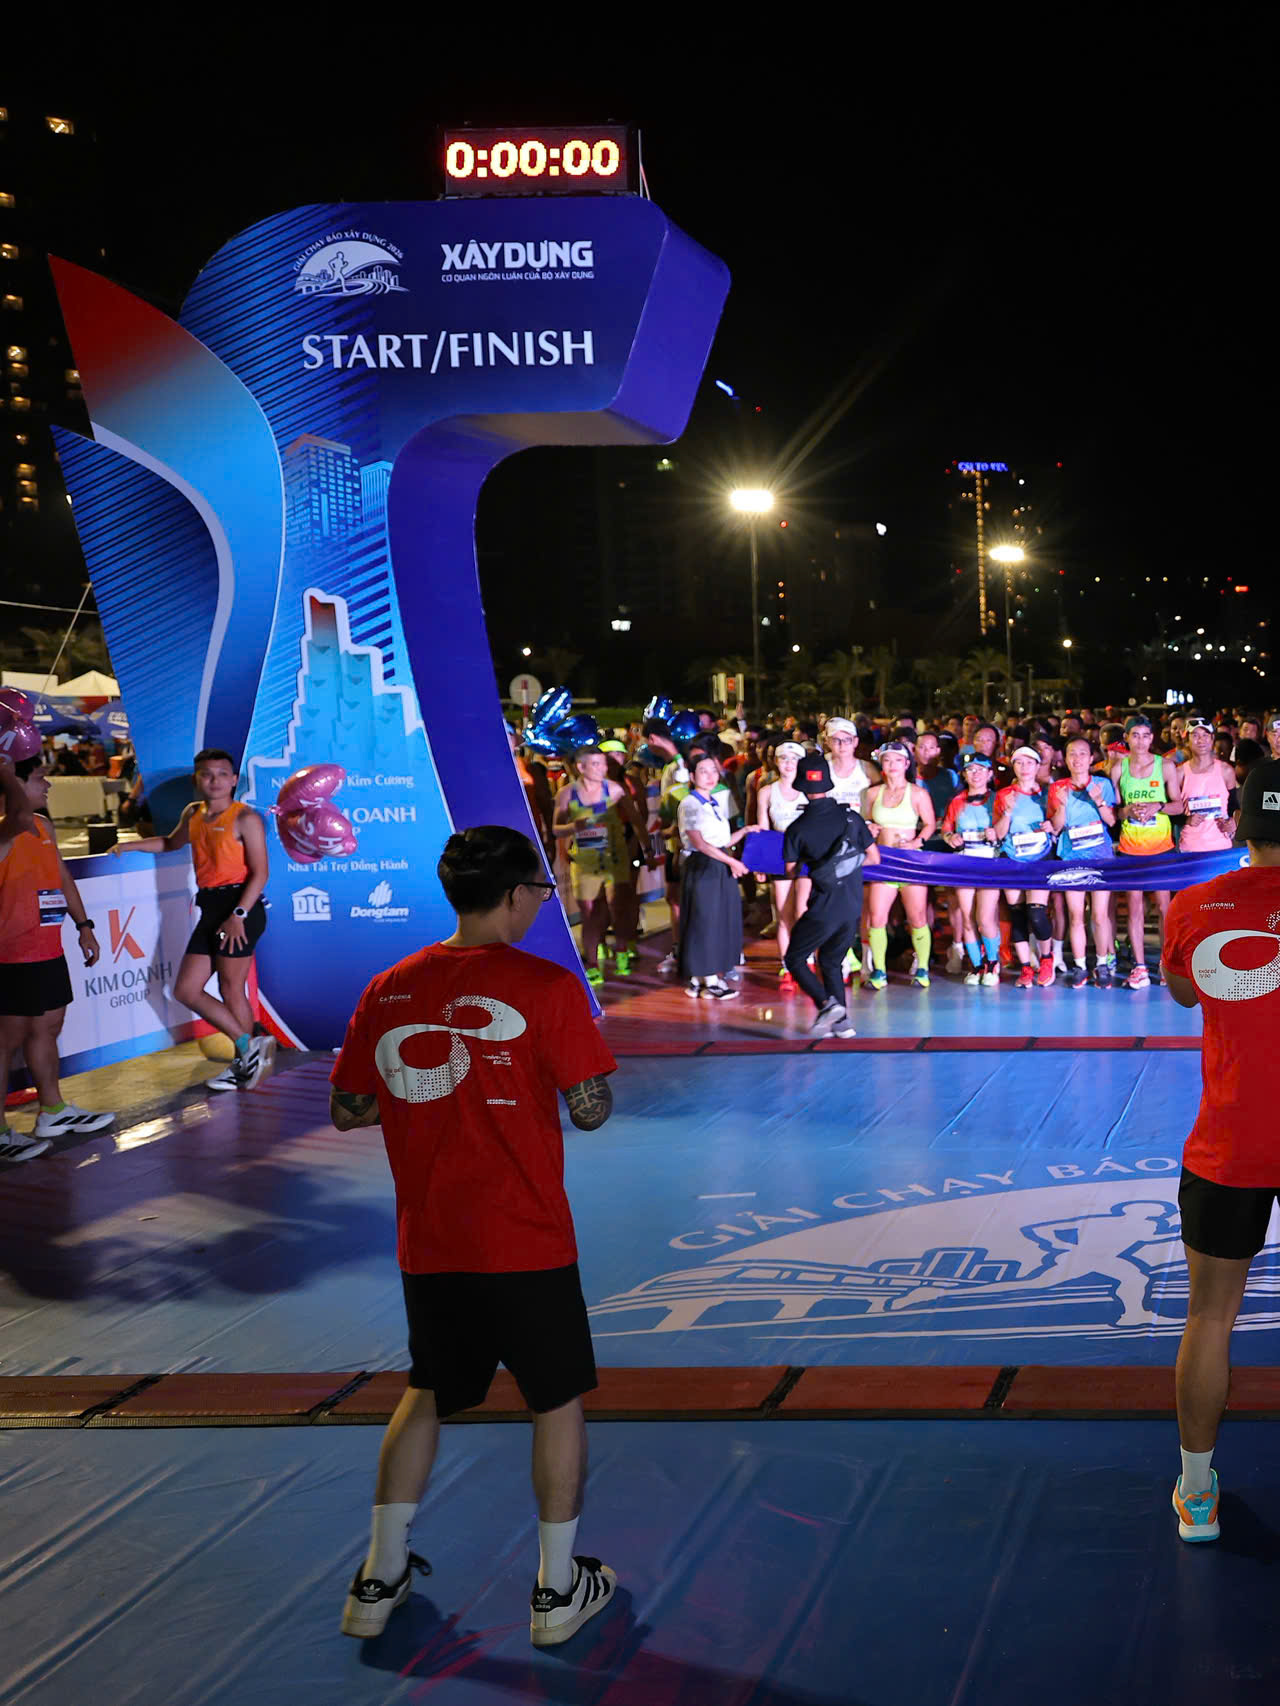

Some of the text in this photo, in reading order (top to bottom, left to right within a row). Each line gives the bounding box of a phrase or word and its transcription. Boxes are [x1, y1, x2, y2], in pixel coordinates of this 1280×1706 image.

[446, 139, 620, 178] 0:00:00
[387, 243, 404, 259] 2026
[454, 273, 476, 283] QUAN
[478, 272, 501, 281] NGÔN
[302, 330, 595, 374] START/FINISH
[347, 775, 371, 787] Kim
[1128, 790, 1156, 800] eBRC
[352, 807, 417, 823] OANH
[294, 896, 331, 913] DIC
[350, 907, 409, 919] Dongtam
[85, 961, 172, 997] KIM OANH
[110, 989, 151, 1008] GROUP
[668, 1207, 822, 1250] GIẢI
[832, 1171, 1014, 1209] CHẠY
[1046, 1155, 1180, 1180] BÁO
